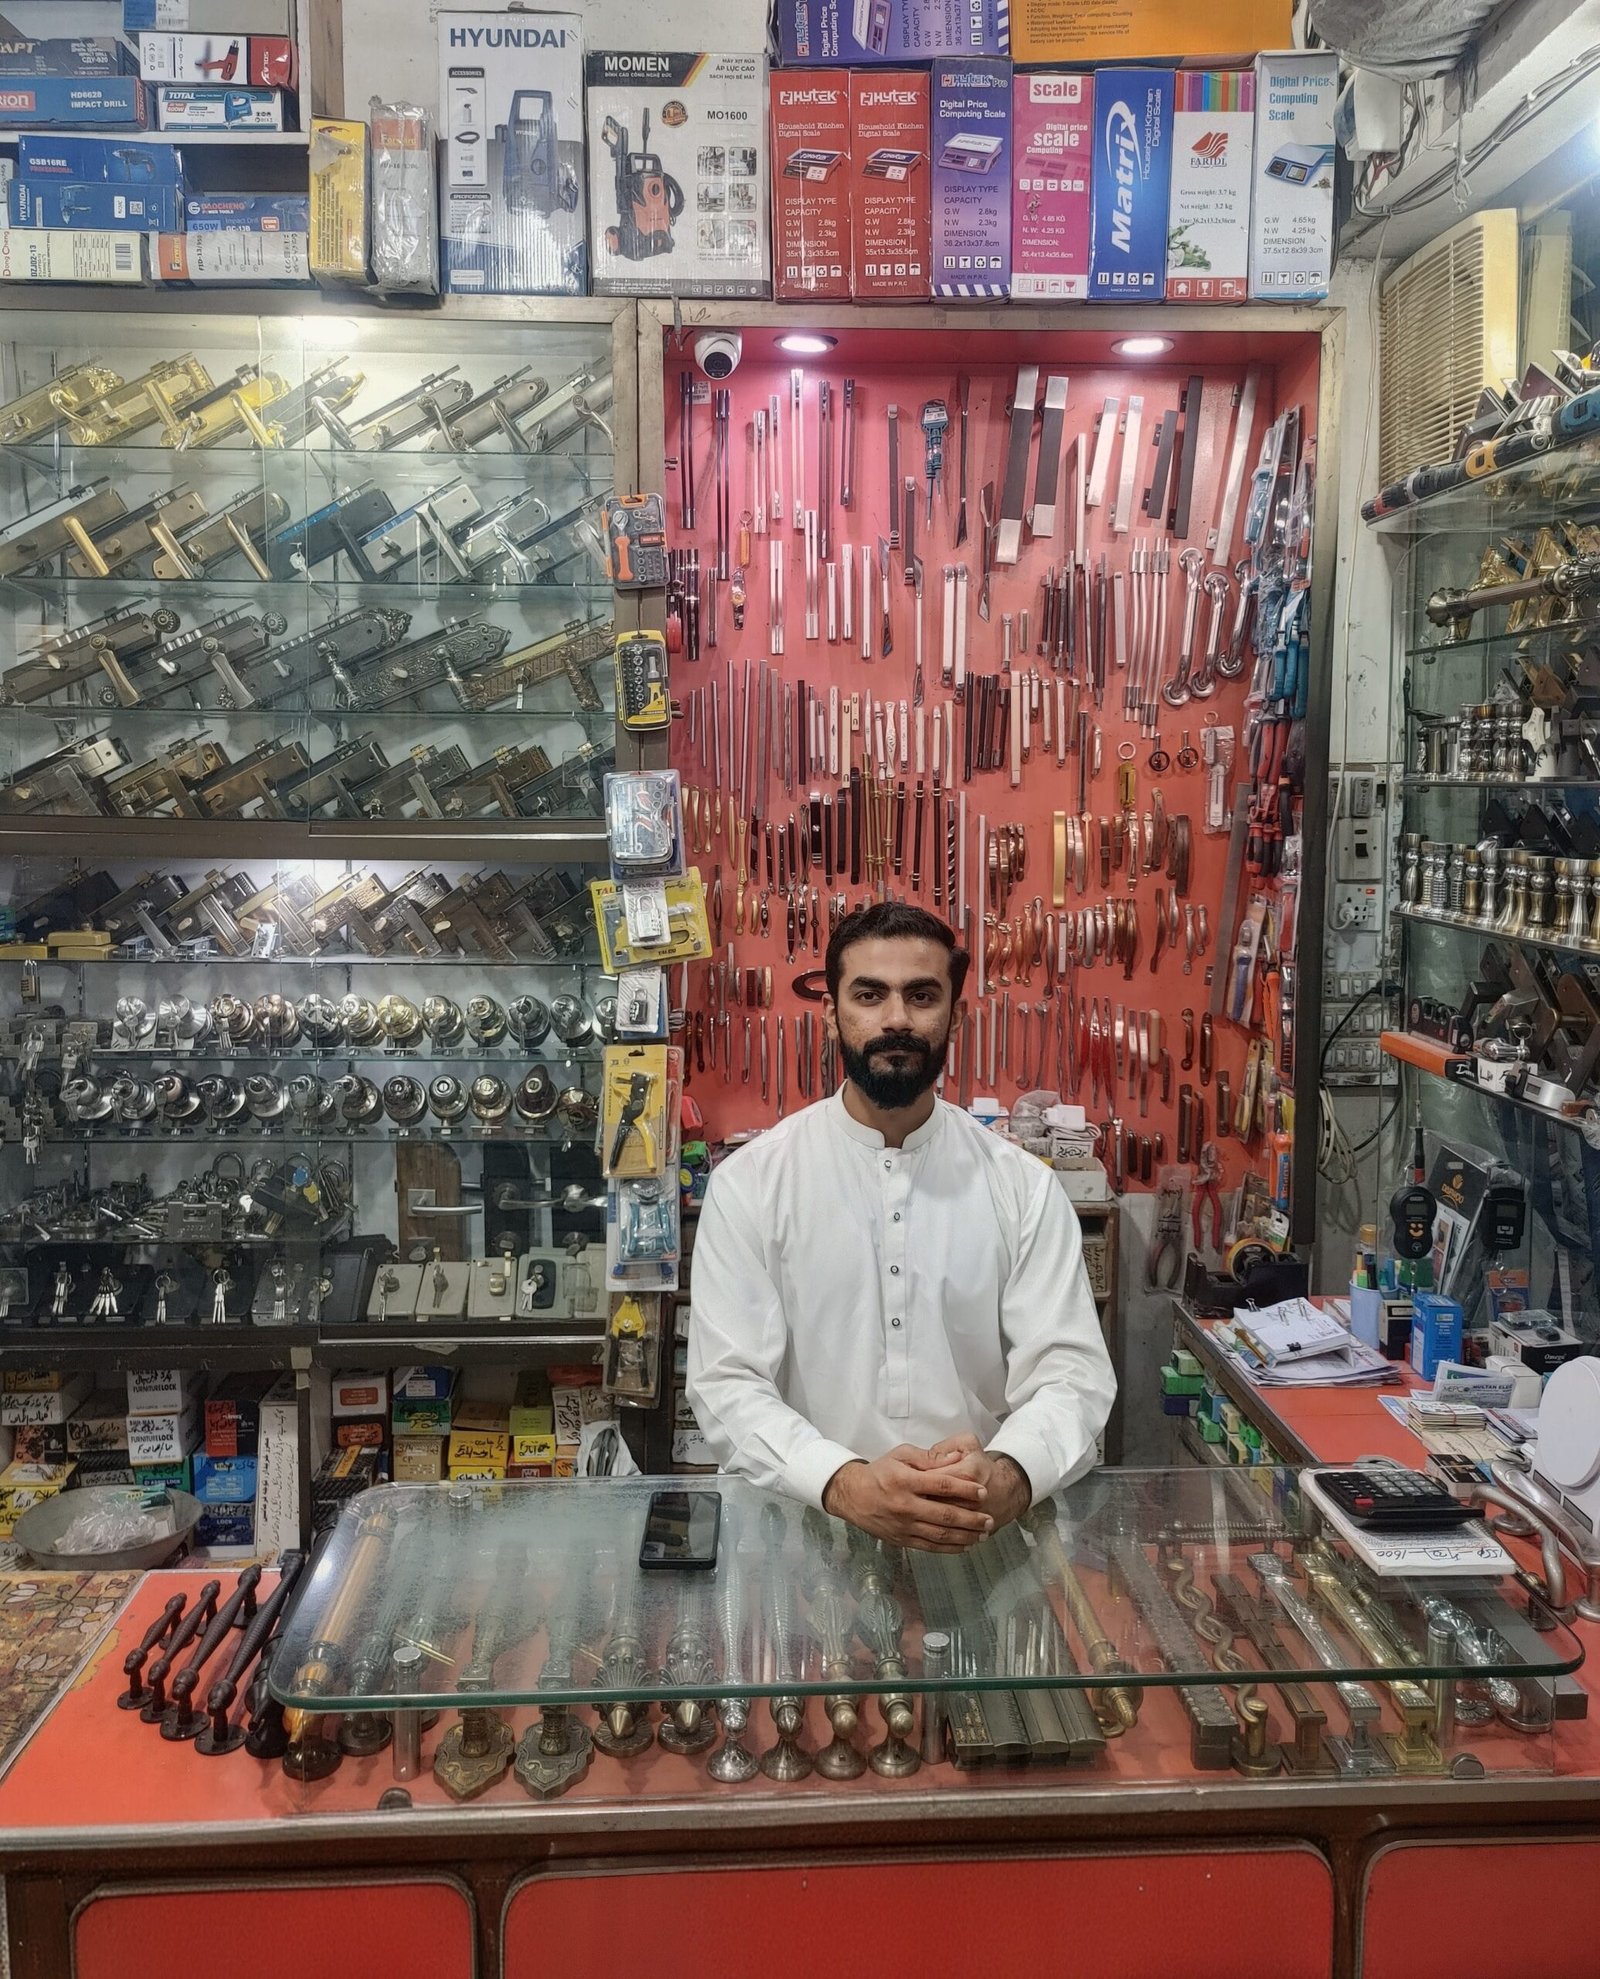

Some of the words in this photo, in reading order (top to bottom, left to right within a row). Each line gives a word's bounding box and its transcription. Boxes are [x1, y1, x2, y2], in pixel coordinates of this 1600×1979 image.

[449, 27, 566, 49] HYUNDAI
[831, 18, 840, 57] Computing
[822, 31, 830, 57] Digital
[604, 56, 670, 72] MOMEN
[1270, 76, 1300, 89] Digital
[1302, 76, 1330, 87] Price
[1033, 81, 1078, 97] scale
[1153, 88, 1162, 113] Scale
[1269, 93, 1318, 105] Computing
[939, 100, 965, 109] Digital
[967, 100, 988, 108] Price
[1145, 88, 1154, 126] Kitchen
[707, 111, 748, 121] MO1600
[939, 110, 982, 119] Computing
[984, 110, 1006, 118] Scale
[1269, 110, 1295, 121] Scale
[778, 122, 816, 130] Household
[858, 122, 896, 130] Household
[1045, 123, 1069, 131] Digital
[1069, 123, 1088, 131] price
[1152, 115, 1162, 147] Digital
[778, 130, 802, 138] Digital
[858, 130, 881, 138] Digital
[1033, 131, 1080, 147] scale
[1026, 146, 1064, 155] Computing
[1142, 127, 1153, 180] Household
[1110, 110, 1137, 254] Matrix
[944, 185, 977, 193] DISPLAY
[978, 185, 999, 193] TYPE
[1228, 189, 1237, 197] kg
[897, 196, 917, 204] TYPE
[944, 196, 983, 204] CAPACITY
[864, 207, 901, 215] CAPACITY
[1224, 203, 1233, 211] kg
[192, 223, 219, 231] 650W
[978, 219, 998, 227] 2.3kg
[818, 230, 837, 238] 2.3kg
[1, 230, 11, 255] Cheng
[786, 240, 828, 248] DIMENSION
[2, 255, 12, 277] Dong
[595, 886, 624, 897] TALC
[132, 1385, 162, 1393] FURNITURE
[161, 1383, 177, 1391] LOCK
[130, 1435, 159, 1443] FURNITURE
[158, 1433, 174, 1441] LOCK
